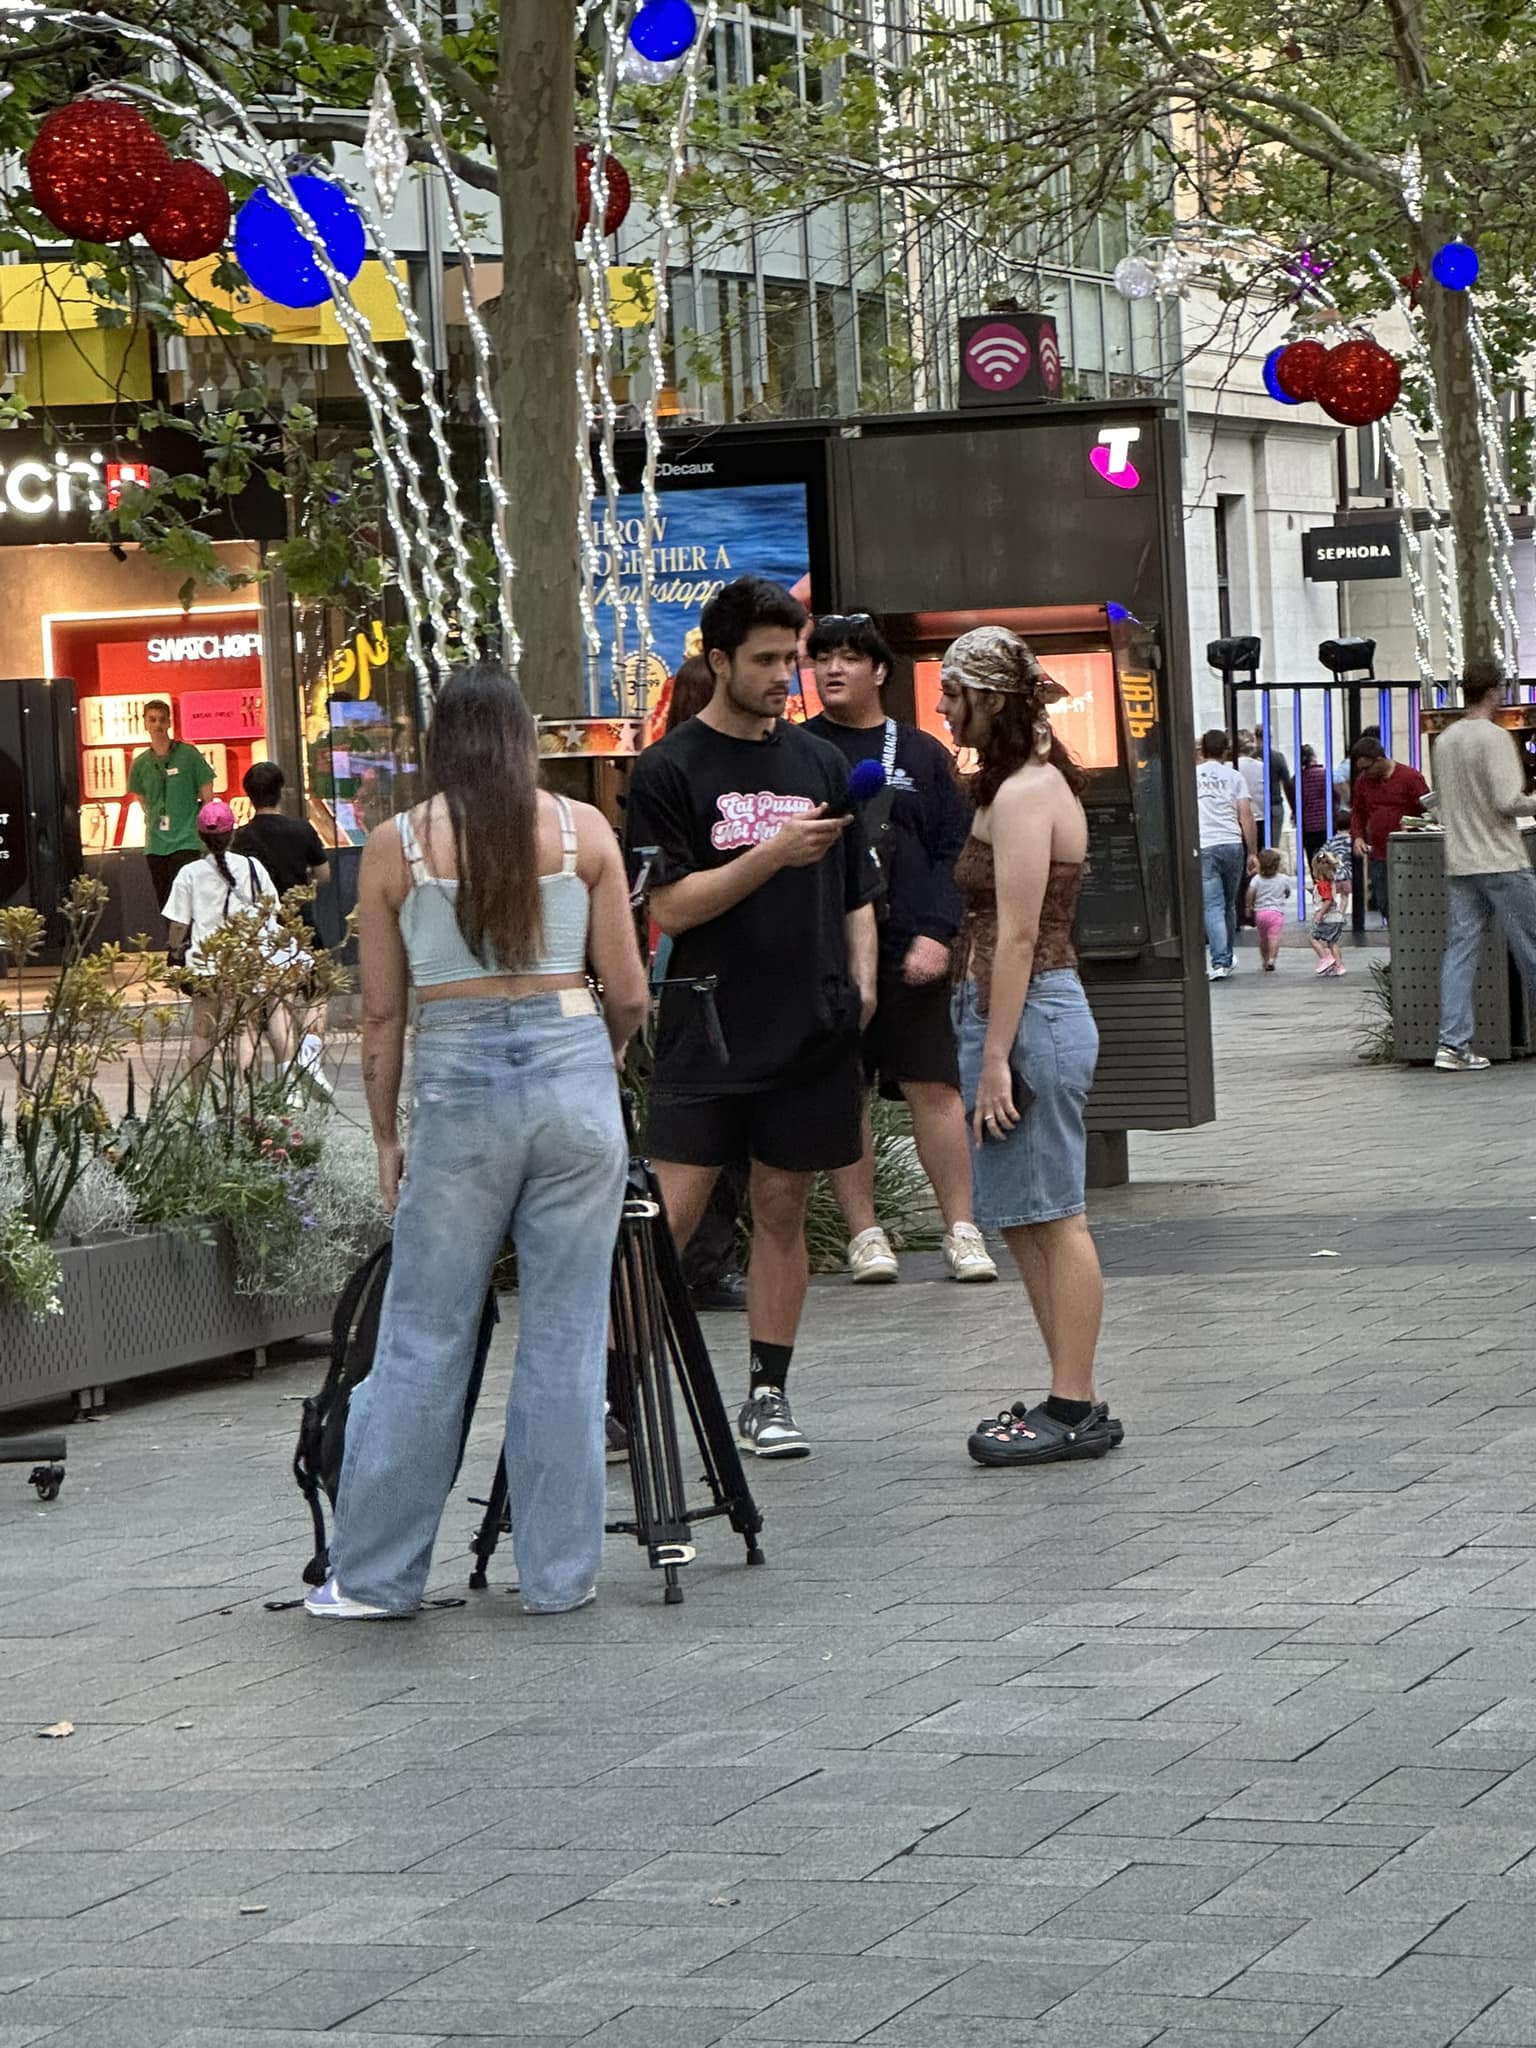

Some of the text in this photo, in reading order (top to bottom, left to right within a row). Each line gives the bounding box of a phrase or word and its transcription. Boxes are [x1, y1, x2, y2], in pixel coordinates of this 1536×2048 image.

[0, 450, 102, 513] ch
[653, 463, 715, 477] CDecaux
[590, 516, 668, 547] HROW
[714, 544, 732, 570] A
[1317, 545, 1391, 561] SEPHORA
